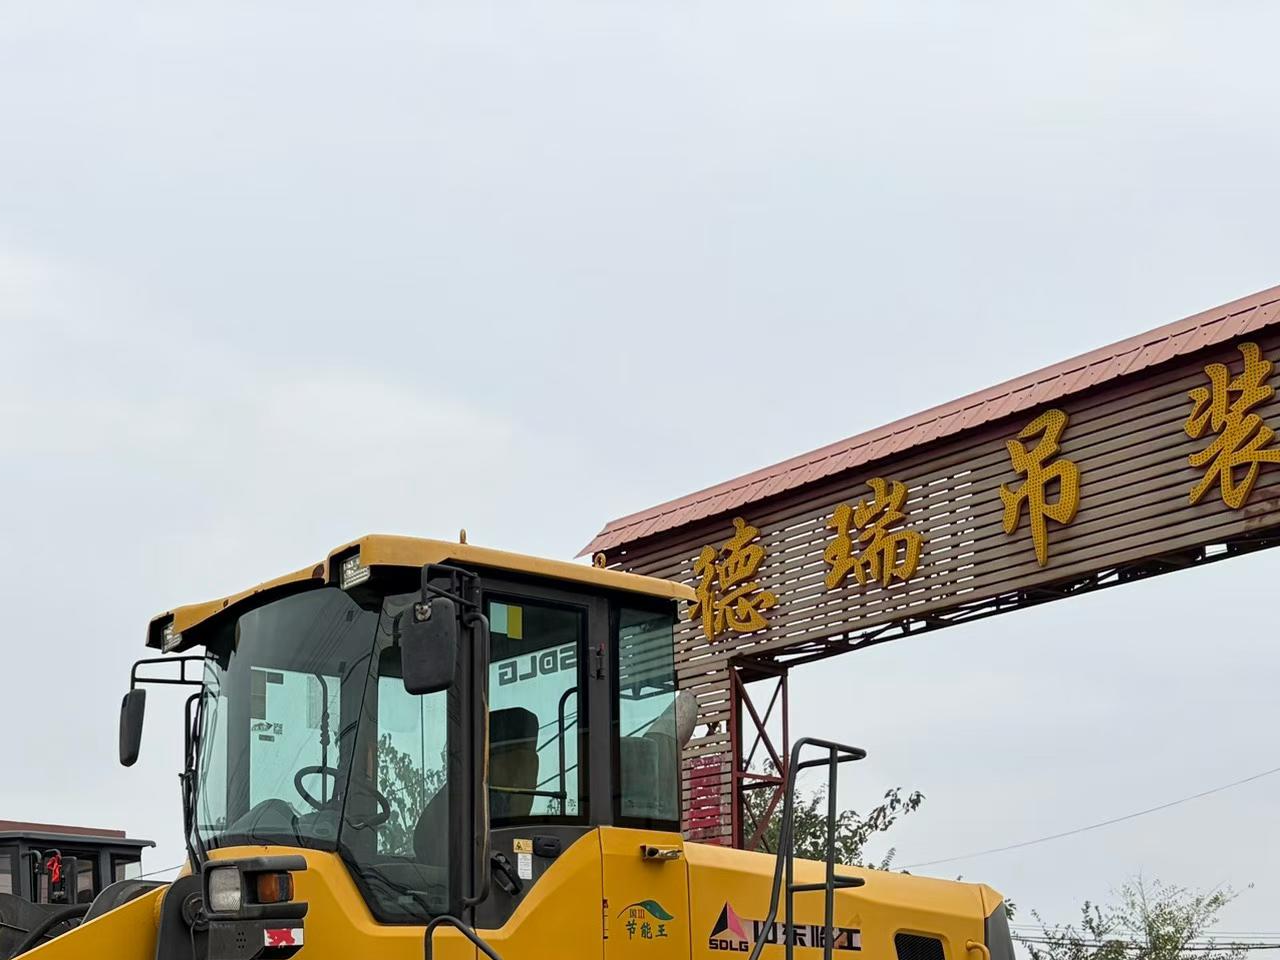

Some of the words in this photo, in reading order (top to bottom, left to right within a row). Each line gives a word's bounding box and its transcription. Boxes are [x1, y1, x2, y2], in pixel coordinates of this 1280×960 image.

[687, 341, 1280, 642] 德瑞吊装
[625, 919, 668, 940] 节能王
[709, 938, 749, 952] SDLG
